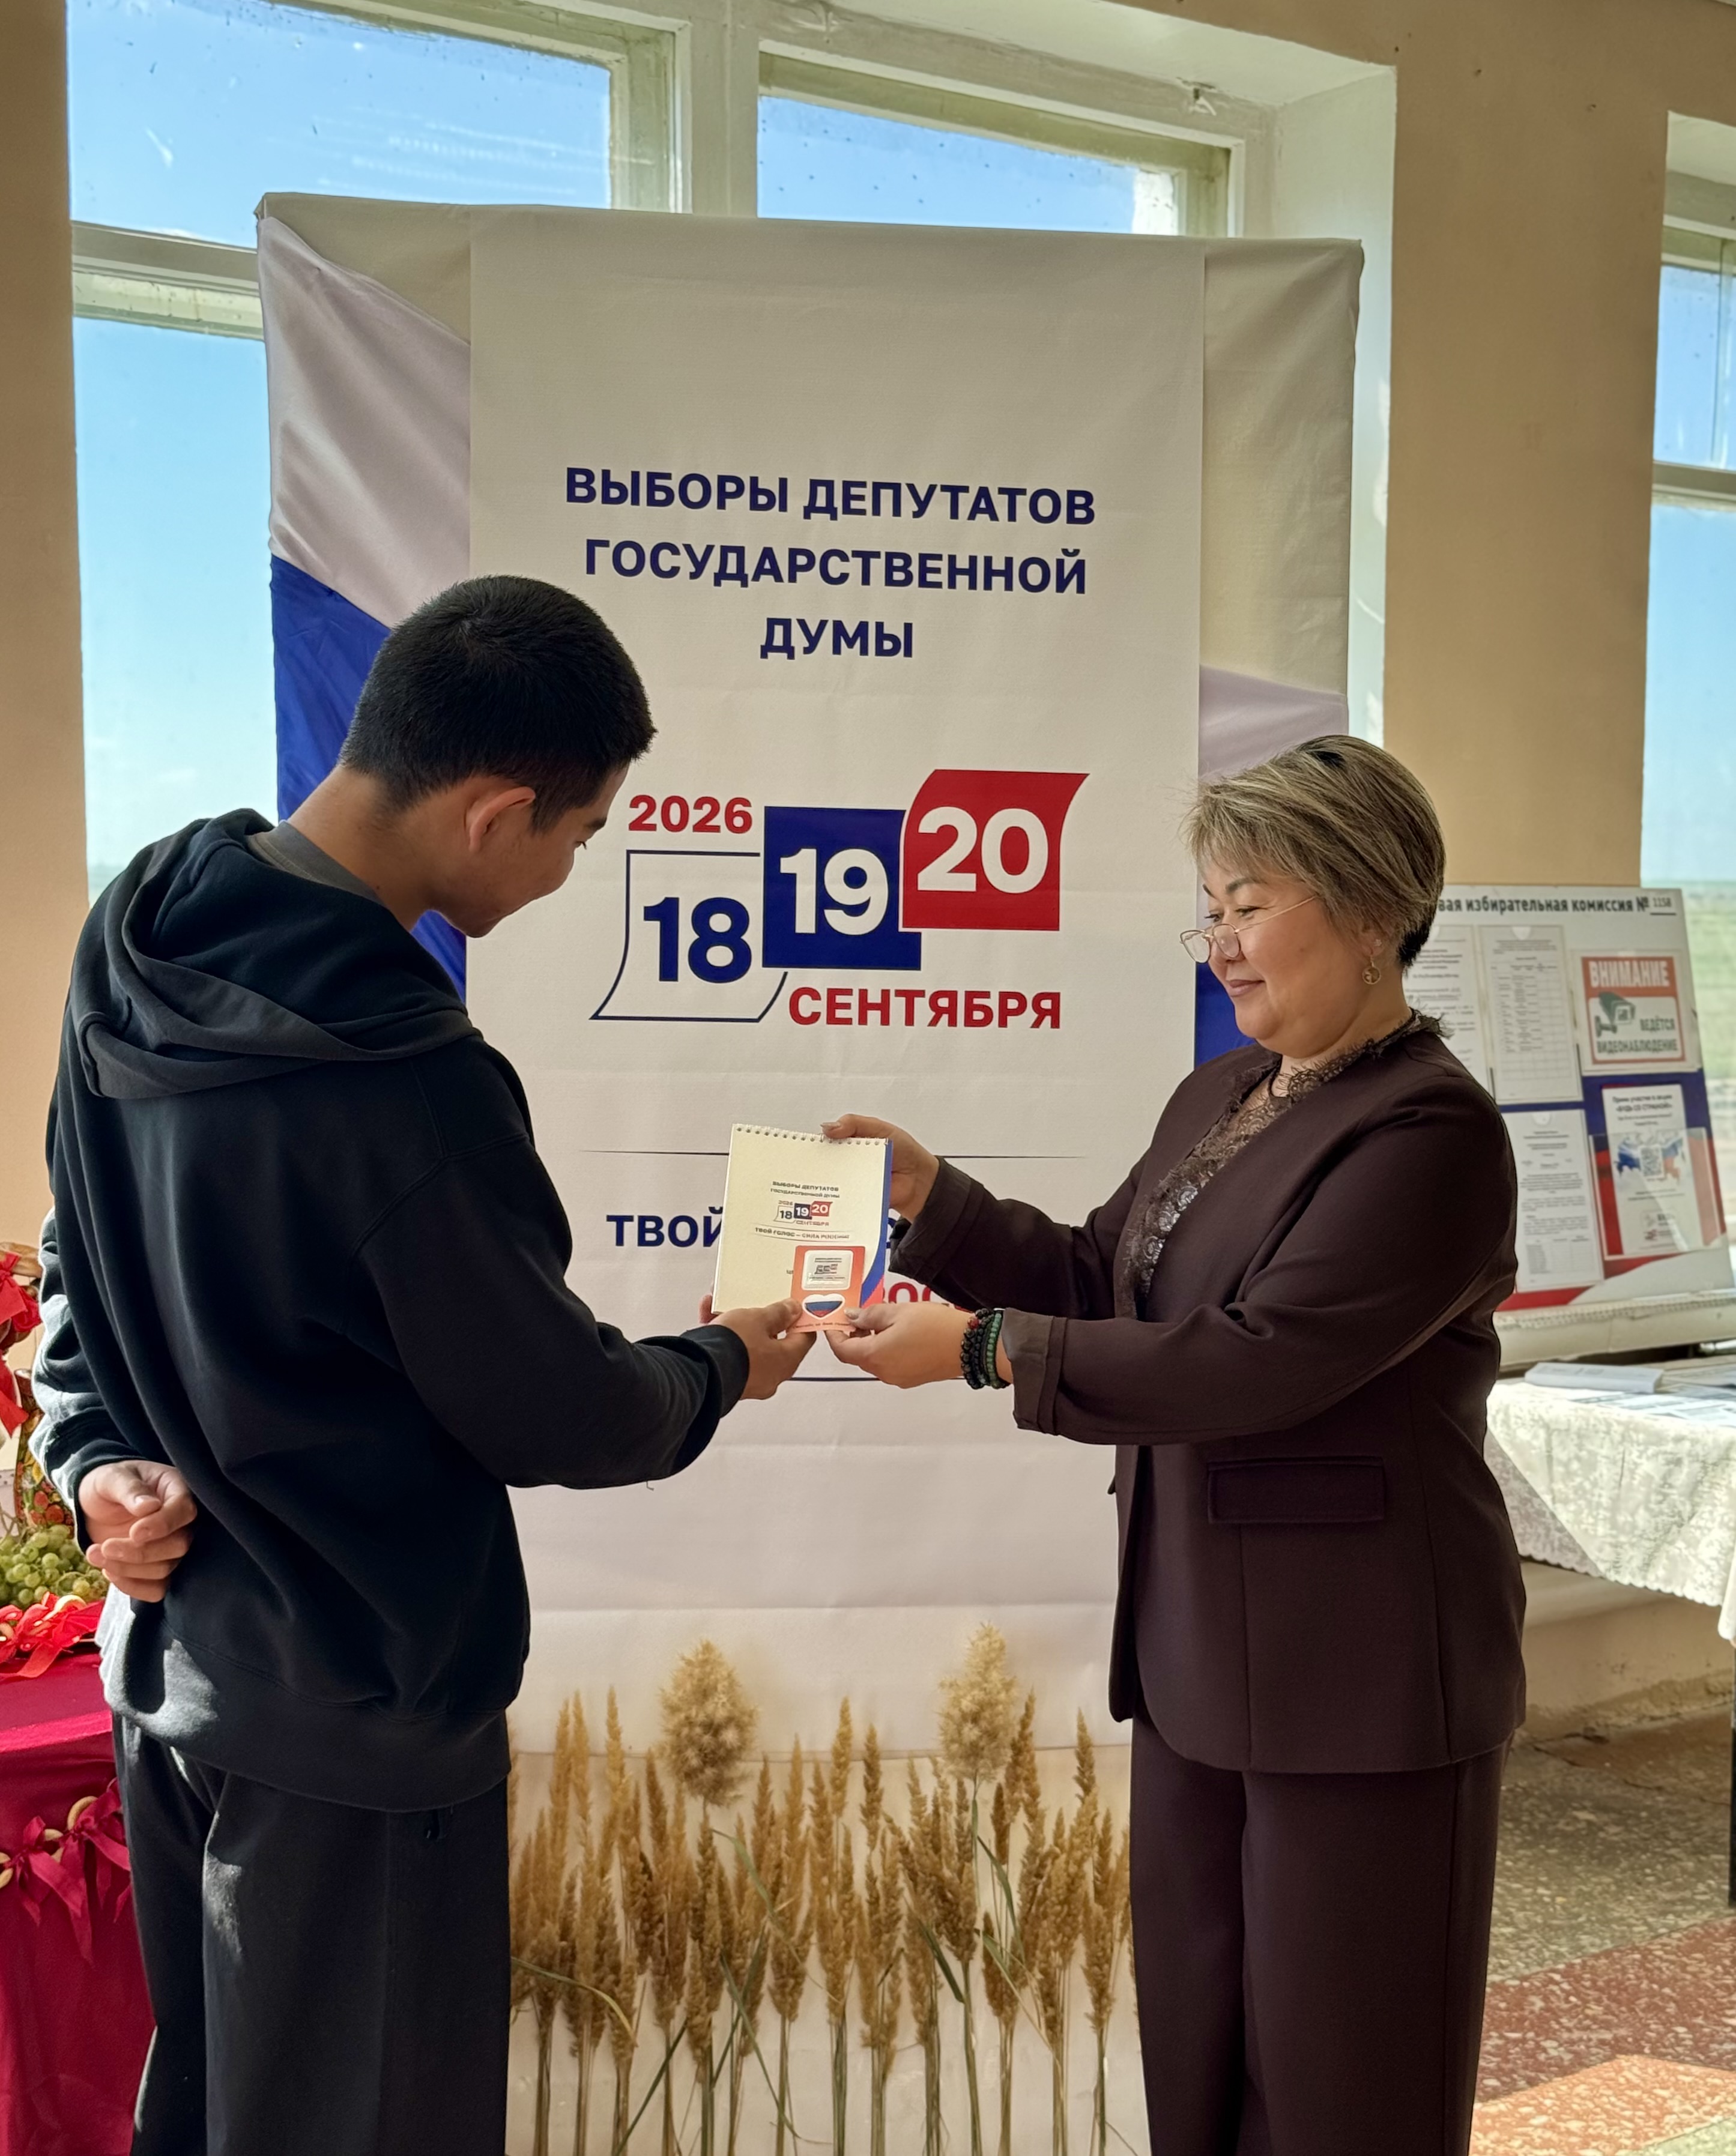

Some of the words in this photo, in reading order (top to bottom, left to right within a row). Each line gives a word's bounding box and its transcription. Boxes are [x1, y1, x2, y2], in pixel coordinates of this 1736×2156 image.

[566, 467, 788, 512] ВЫБОРЫ
[803, 479, 1095, 525] ДЕПУТАТОВ
[585, 539, 1086, 594] ГОСУДАРСТВЕННОЙ
[760, 617, 913, 660] ДУМЫ
[629, 794, 752, 834] 2026
[917, 806, 1048, 893] 20
[780, 848, 889, 935] 19
[1438, 898, 1463, 912] вая
[1465, 895, 1568, 916] избирательная
[1571, 899, 1633, 913] комиссия
[643, 896, 752, 983] 18
[1588, 961, 1670, 988] ВНИМАНИЕ
[788, 987, 1060, 1028] СЕНТЯБРЯ
[1596, 1039, 1678, 1055] ВИДЕОНАБЛЮДЕНИЕ
[770, 1188, 823, 1197] ГОСУДАРСТВЕННОЙ
[772, 1181, 800, 1189] ВЫБОРЫ
[606, 1206, 723, 1248] ТВОЙ
[779, 1210, 793, 1219] 18
[795, 1207, 809, 1216] 19
[811, 1204, 829, 1213] 20
